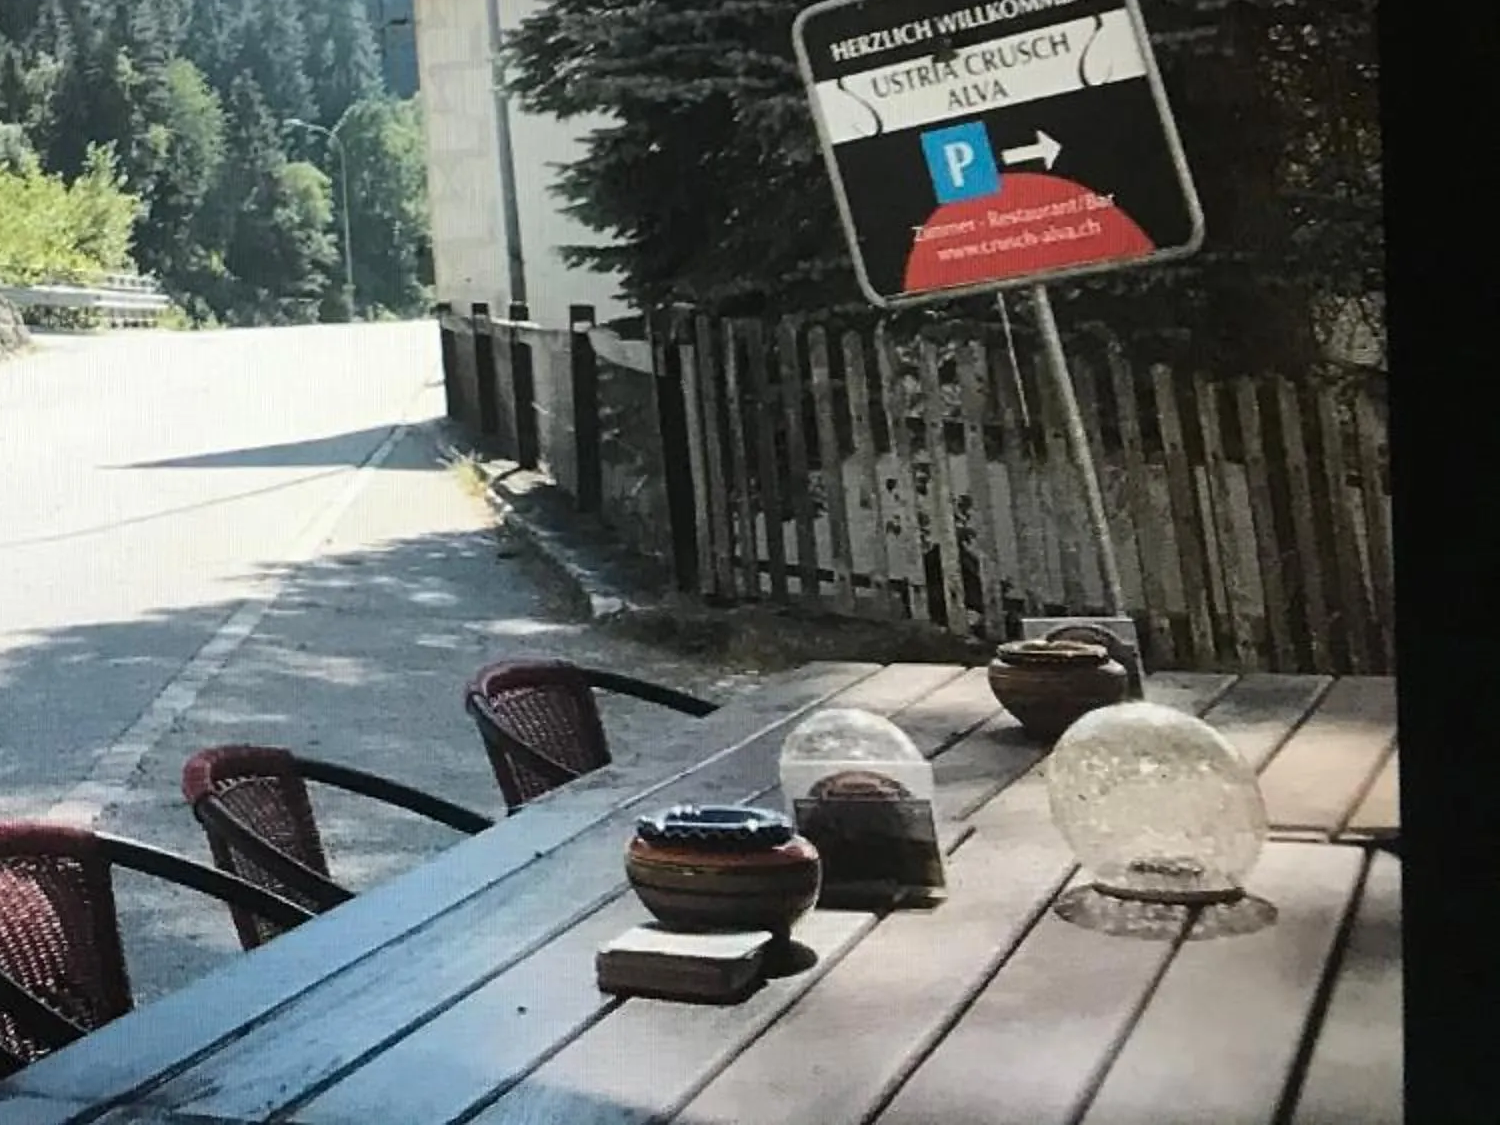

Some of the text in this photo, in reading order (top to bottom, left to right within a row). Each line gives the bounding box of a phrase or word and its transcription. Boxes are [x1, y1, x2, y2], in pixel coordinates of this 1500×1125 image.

[830, 19, 934, 62] HERZLICH
[871, 31, 1071, 99] USTRIA CRUSCH
[948, 78, 1010, 111] ALVA
[943, 142, 975, 188] P
[912, 219, 976, 243] Zimmer
[937, 218, 1102, 261] www.crusch-alva.ch
